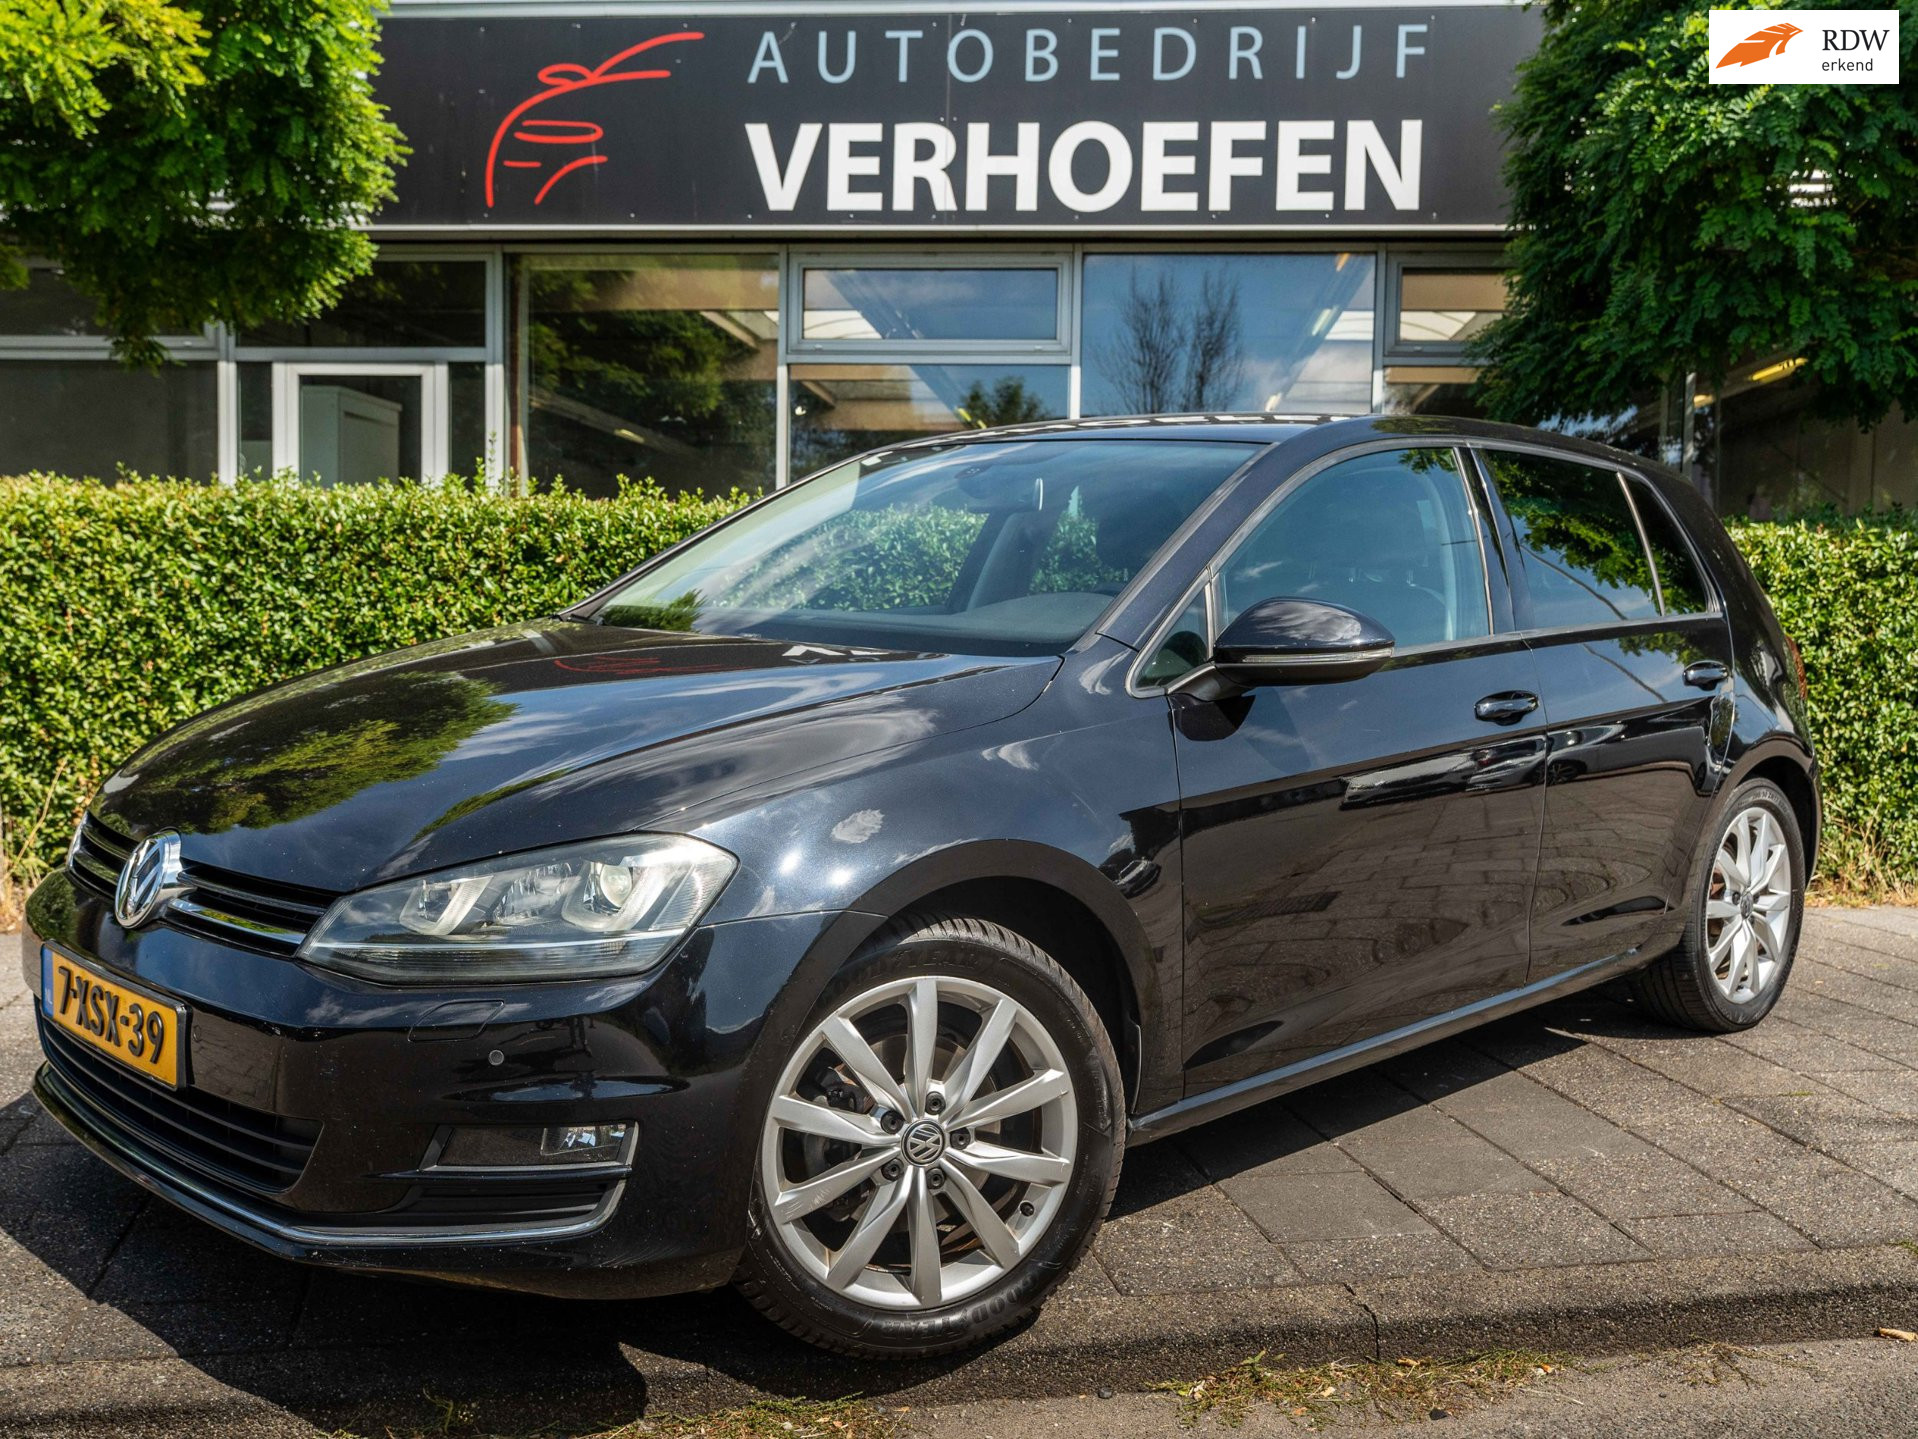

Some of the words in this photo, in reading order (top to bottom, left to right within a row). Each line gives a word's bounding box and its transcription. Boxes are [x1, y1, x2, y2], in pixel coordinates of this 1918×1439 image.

[748, 24, 1428, 83] AUTOBEDRIJF
[745, 118, 1423, 212] VERHOEFEN
[58, 965, 164, 1065] 7-XSX-39
